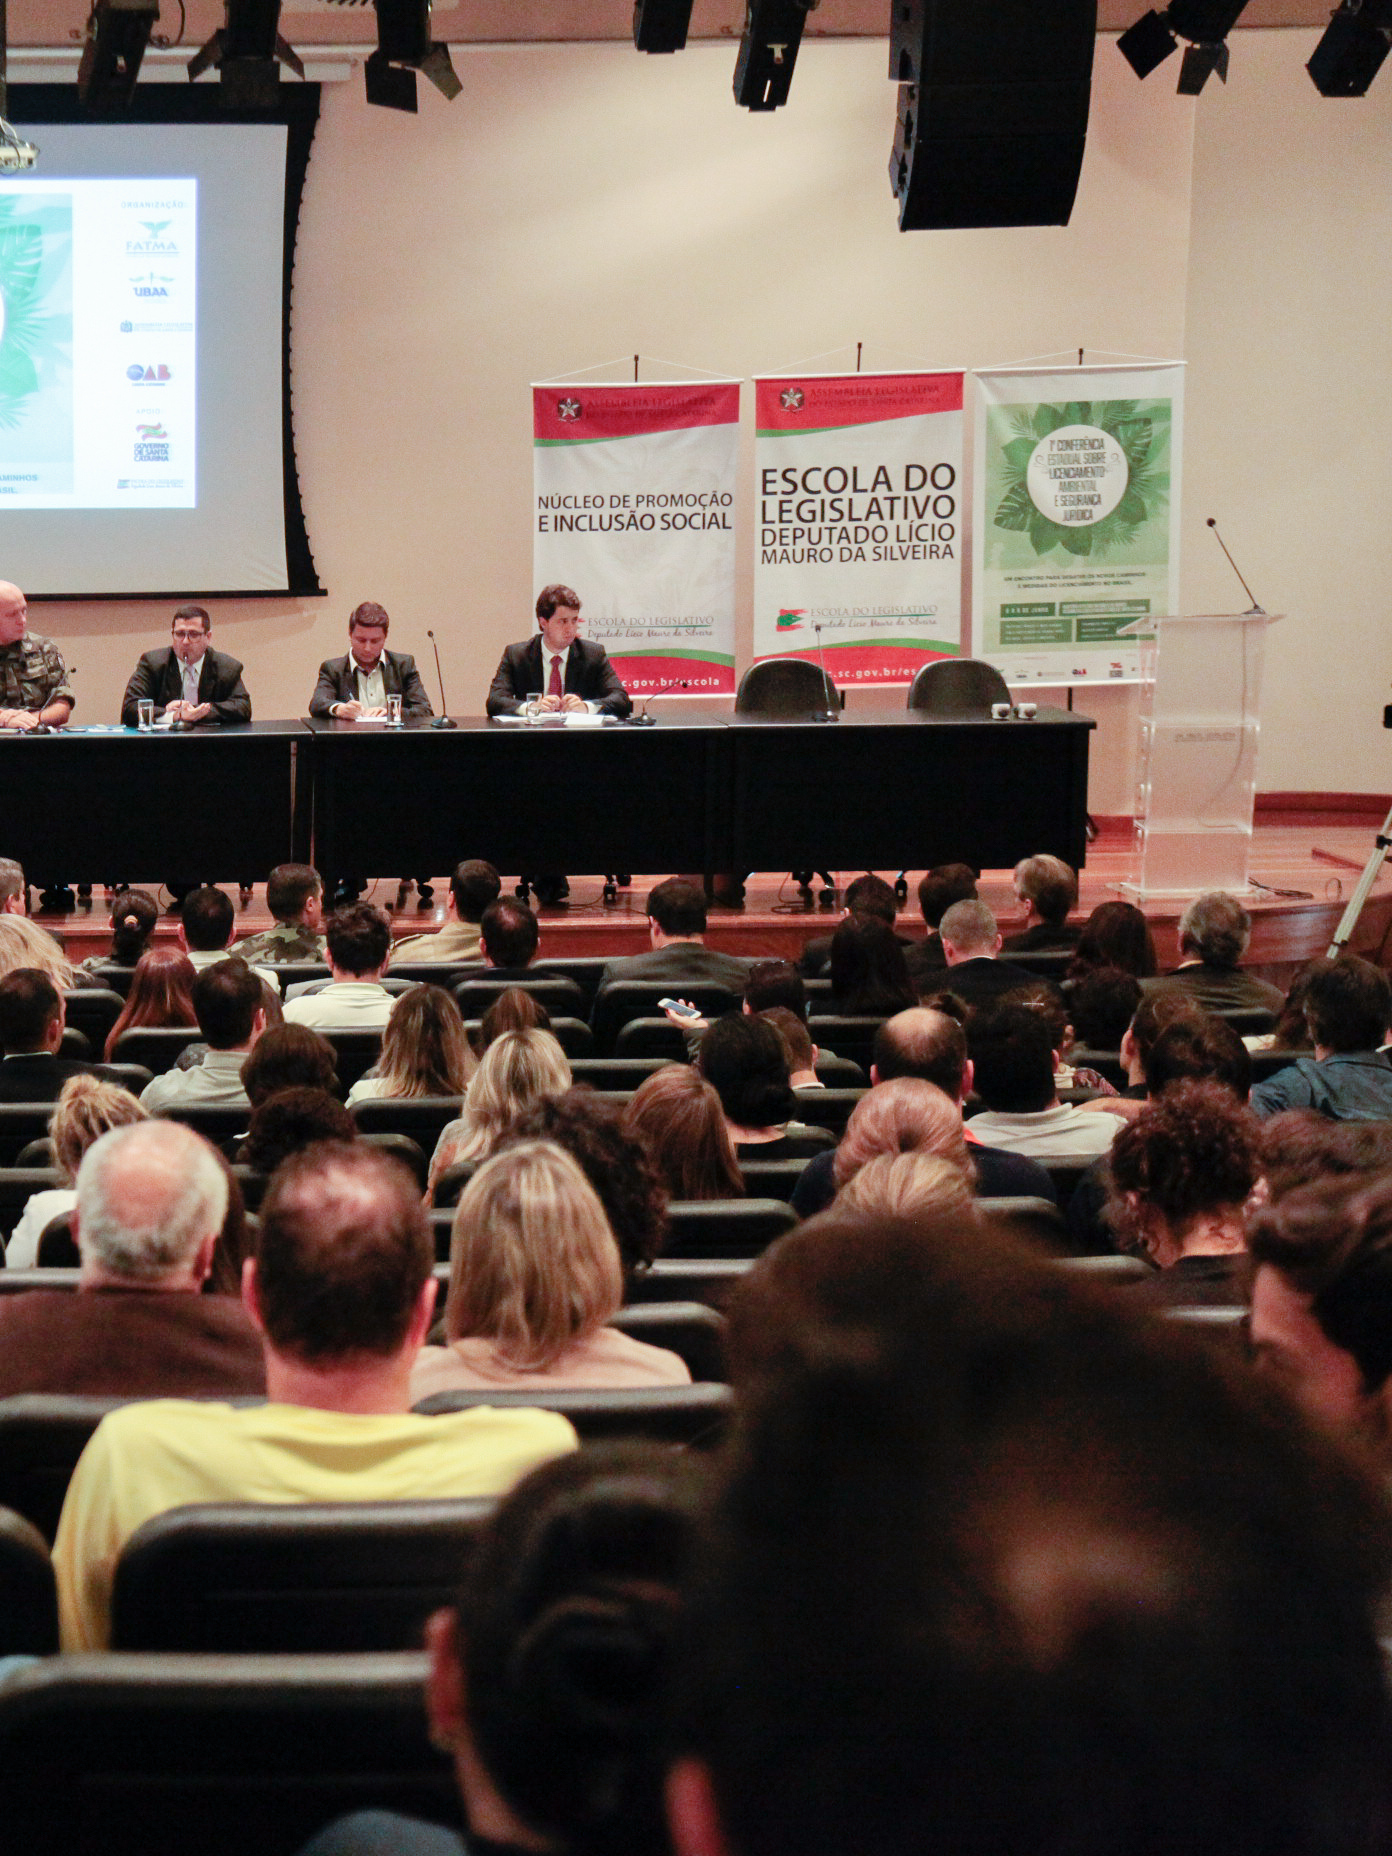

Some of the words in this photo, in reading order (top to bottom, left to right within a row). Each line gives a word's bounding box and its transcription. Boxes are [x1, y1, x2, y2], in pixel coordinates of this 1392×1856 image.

[125, 241, 178, 251] FATMA
[133, 286, 168, 297] UBAA
[126, 363, 171, 381] OAB
[1057, 435, 1105, 451] CONFERÊNCIA
[1047, 454, 1081, 466] ESTADUAL
[1083, 452, 1106, 464] SOBRE
[761, 465, 893, 496] ESCOLA
[905, 462, 956, 492] DO
[1049, 466, 1105, 479] LICENCIAMENTO
[1058, 480, 1097, 492] AMBIENTAL
[538, 492, 605, 509] NÚCLEO
[609, 494, 631, 509] DE
[636, 490, 733, 510] PROMOÇÃO
[1054, 494, 1059, 506] E
[761, 494, 956, 524] LEGISLATIVO
[538, 515, 549, 532] E
[554, 511, 656, 532] INCLUSÃO
[660, 512, 733, 531] SOCIAL
[761, 525, 889, 547] DEPUTADO
[896, 520, 955, 543] LÍCIO
[761, 547, 834, 564] MAURO
[840, 546, 866, 562] DA
[872, 544, 954, 561] SILVEIRA
[811, 607, 849, 617] ESCOLA
[852, 607, 870, 616] DO
[872, 604, 938, 615] LEGISLATIVO
[588, 617, 626, 626] ESCOLA
[629, 617, 646, 626] DO
[649, 615, 714, 625] LEGISLATIVO
